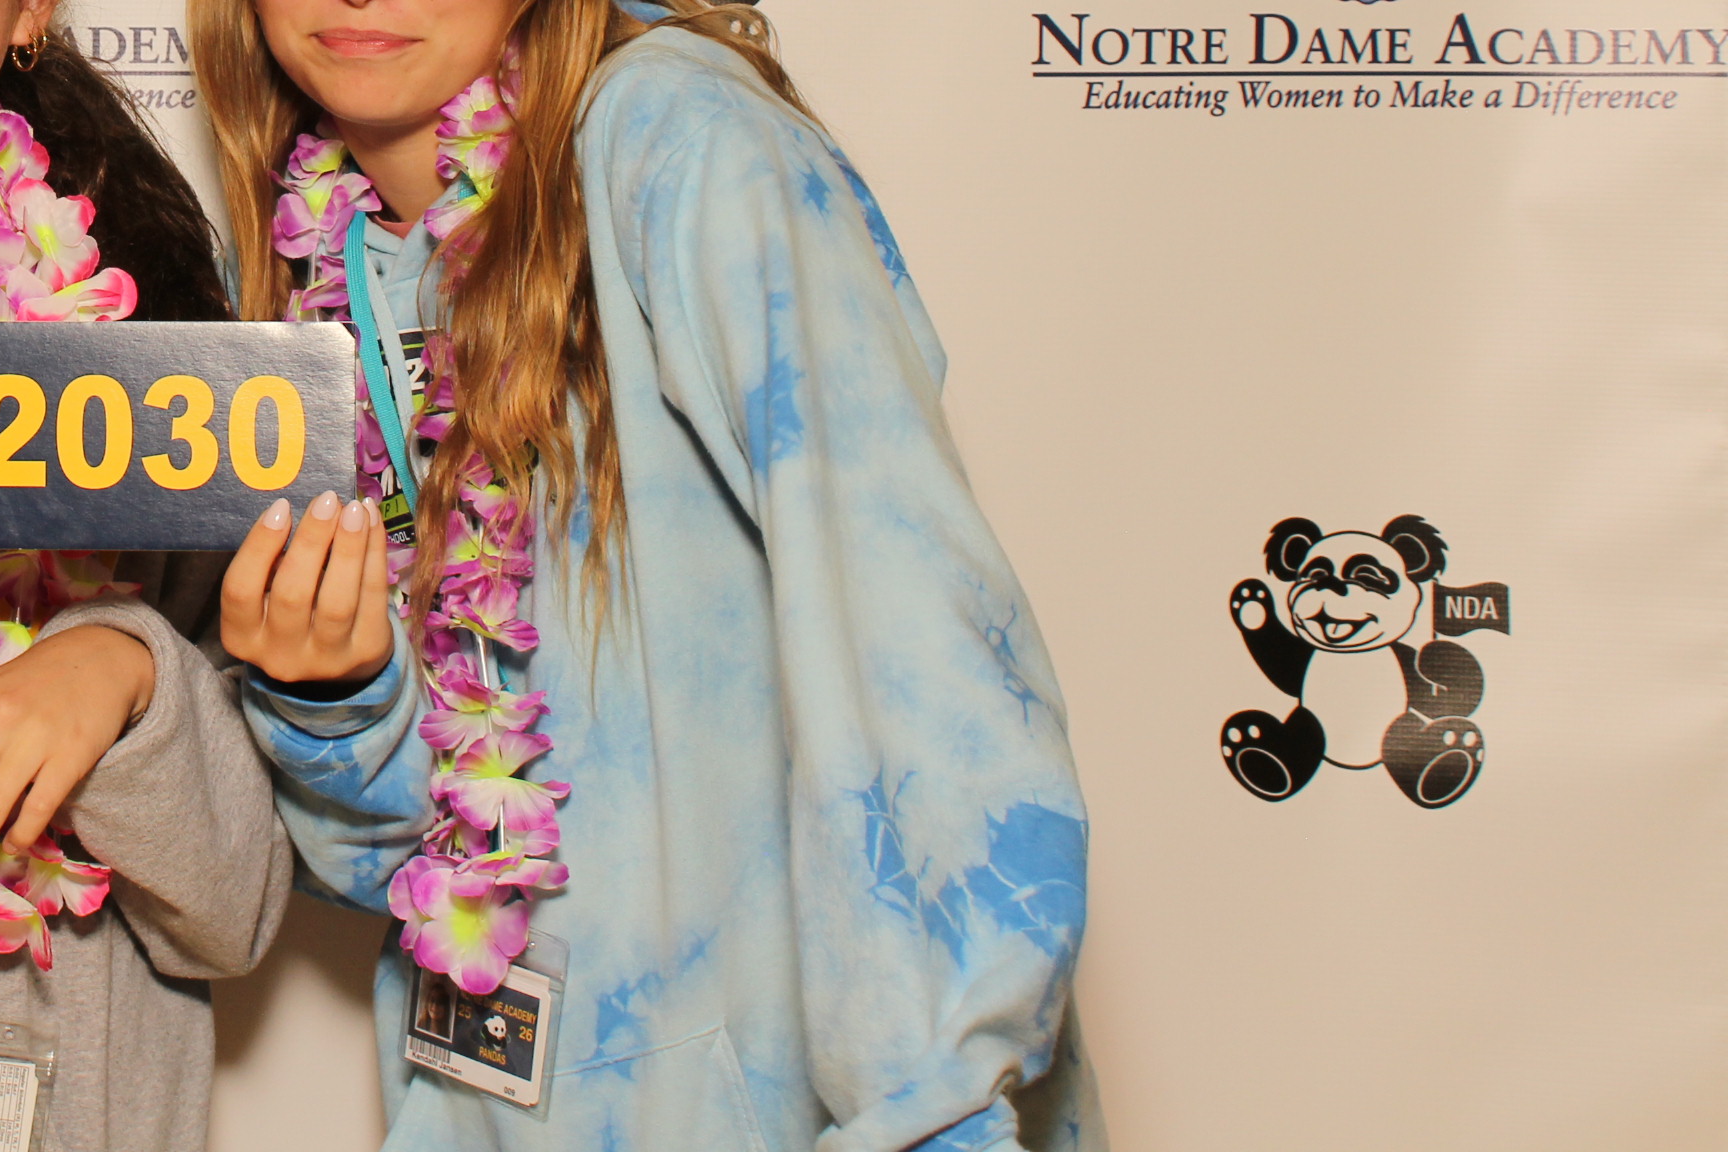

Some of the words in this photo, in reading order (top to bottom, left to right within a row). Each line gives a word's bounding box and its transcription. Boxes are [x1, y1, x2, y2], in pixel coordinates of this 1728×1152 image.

[1031, 14, 1229, 66] NOTRE
[1248, 13, 1413, 64] DAME
[1433, 12, 1728, 65] ACADEMY
[1081, 79, 1229, 117] Educating
[1237, 81, 1344, 108] Women
[1353, 85, 1381, 108] to
[1388, 79, 1474, 108] Make
[1483, 89, 1502, 108] a
[1511, 80, 1678, 115] Difference
[1445, 595, 1499, 620] NDA
[458, 1004, 471, 1019] 25
[519, 1025, 534, 1042] 26
[503, 1004, 537, 1024] ACADEMY
[479, 1046, 507, 1065] PANDAS
